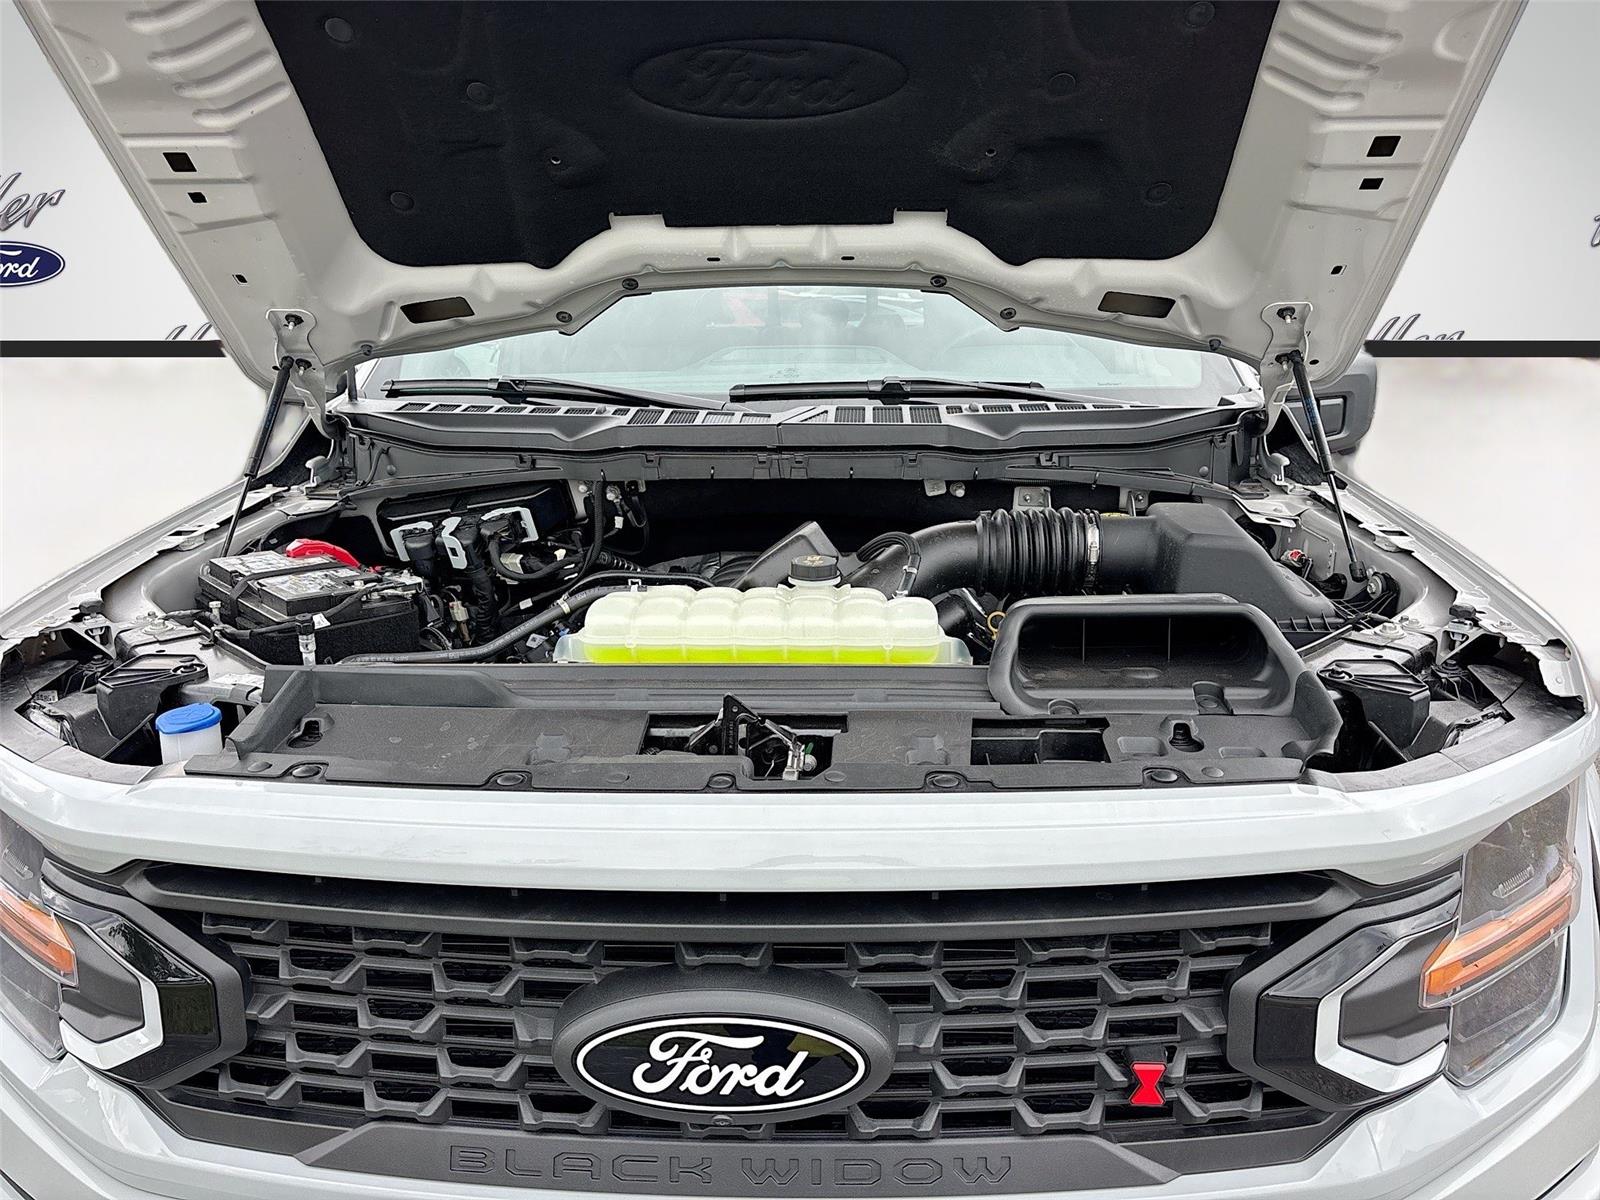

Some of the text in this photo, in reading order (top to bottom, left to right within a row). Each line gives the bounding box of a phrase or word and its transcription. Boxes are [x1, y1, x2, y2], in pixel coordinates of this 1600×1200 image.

[671, 46, 860, 108] Ford
[632, 1031, 809, 1097] Ford
[450, 1145, 1011, 1185] BLACK WIDOW
